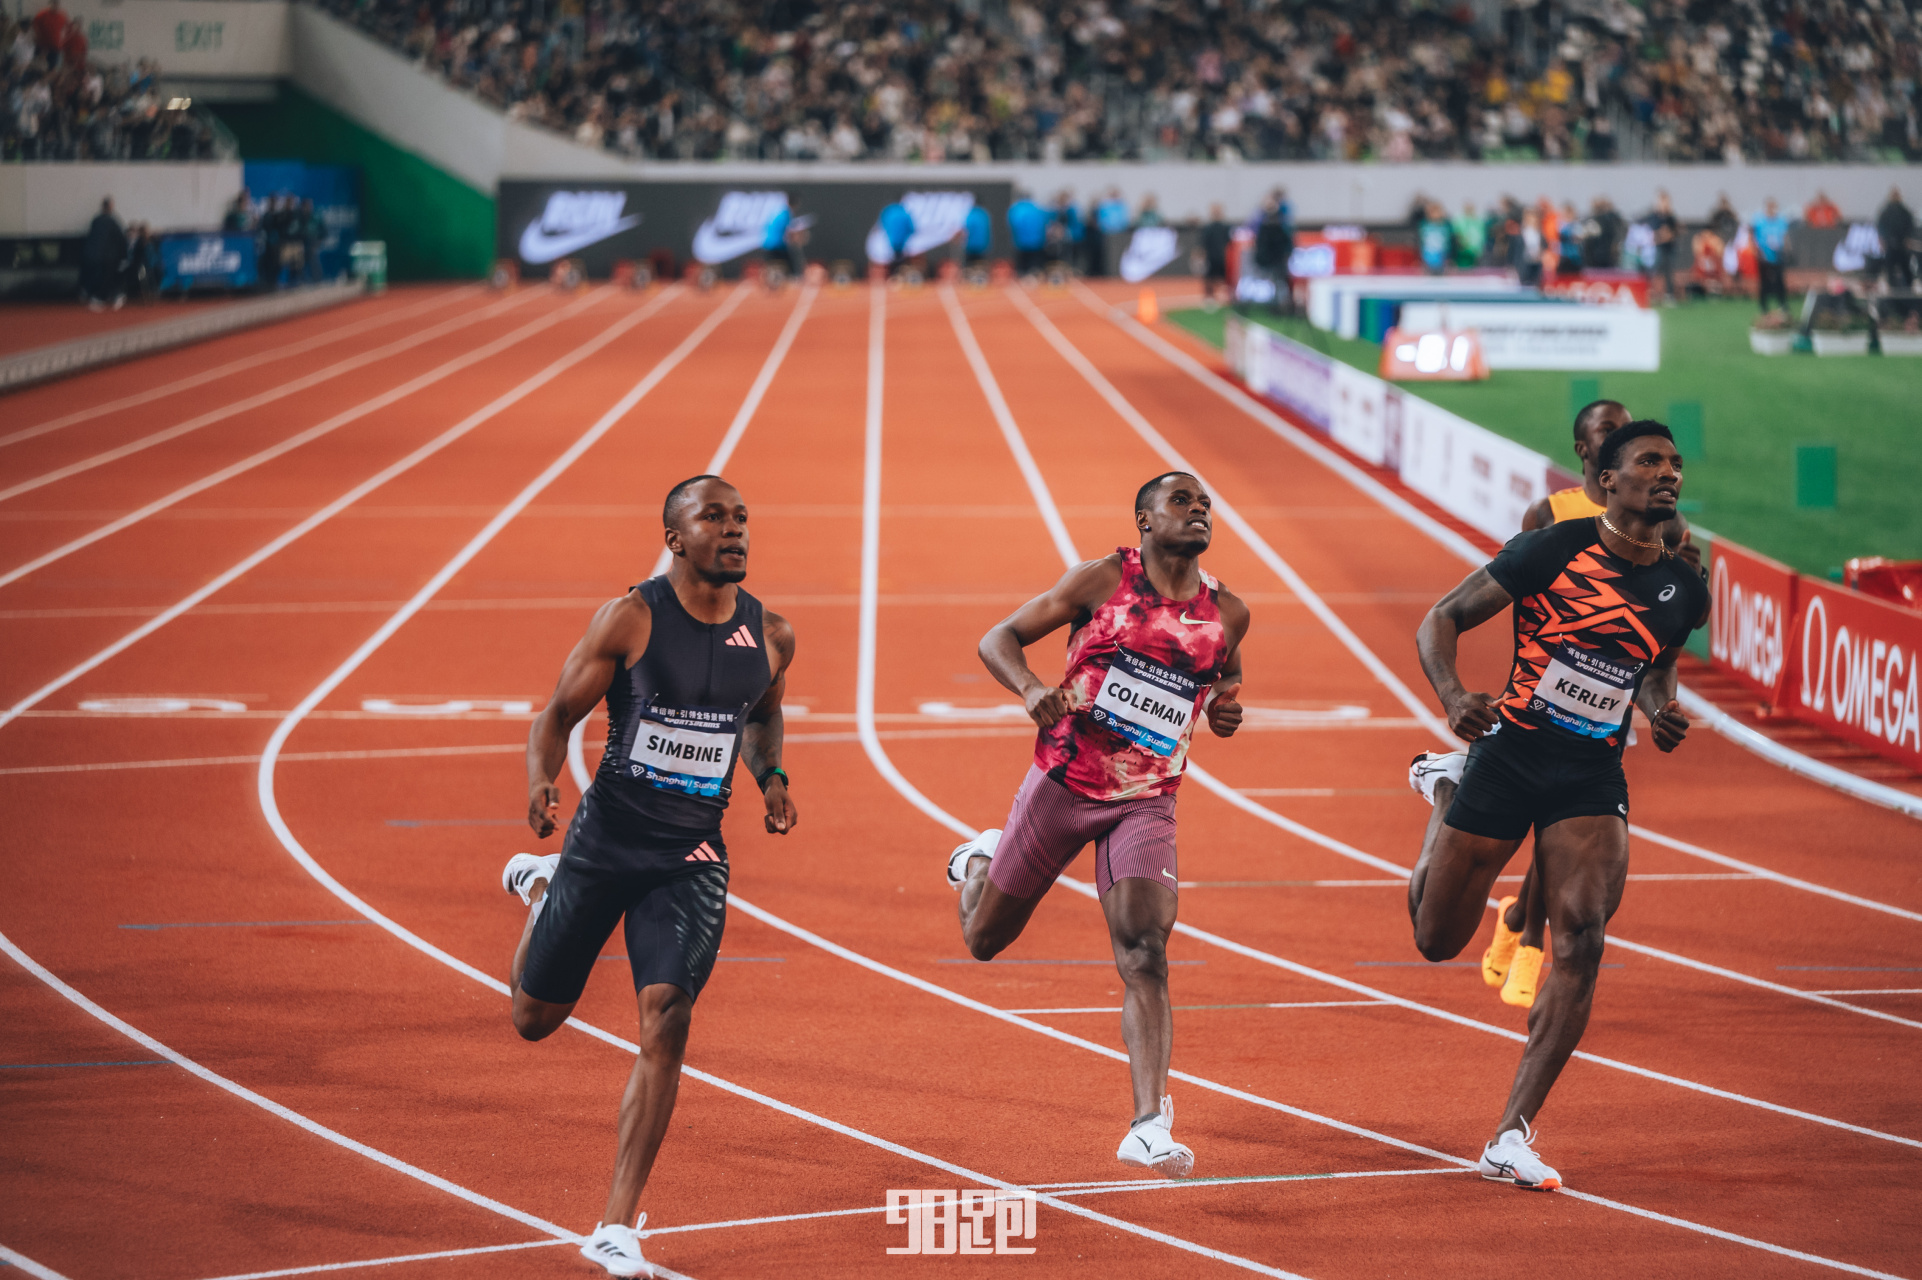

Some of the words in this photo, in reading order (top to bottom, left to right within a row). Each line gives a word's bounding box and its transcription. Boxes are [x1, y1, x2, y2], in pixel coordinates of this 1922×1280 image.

[174, 20, 225, 52] EXIT
[1730, 580, 1784, 690] OMEGA
[1133, 667, 1183, 691] SPORTSBEAMS
[1554, 677, 1621, 712] KERLEY
[1831, 624, 1922, 754] OMEGA
[1107, 682, 1186, 727] COLEMAN
[1545, 706, 1583, 727] Shanghai
[646, 735, 724, 763] SIMBINE
[1106, 717, 1142, 737] Shanghai
[1145, 734, 1172, 751] Suzhou
[645, 771, 688, 787] Shanghai
[693, 781, 719, 791] Suzho
